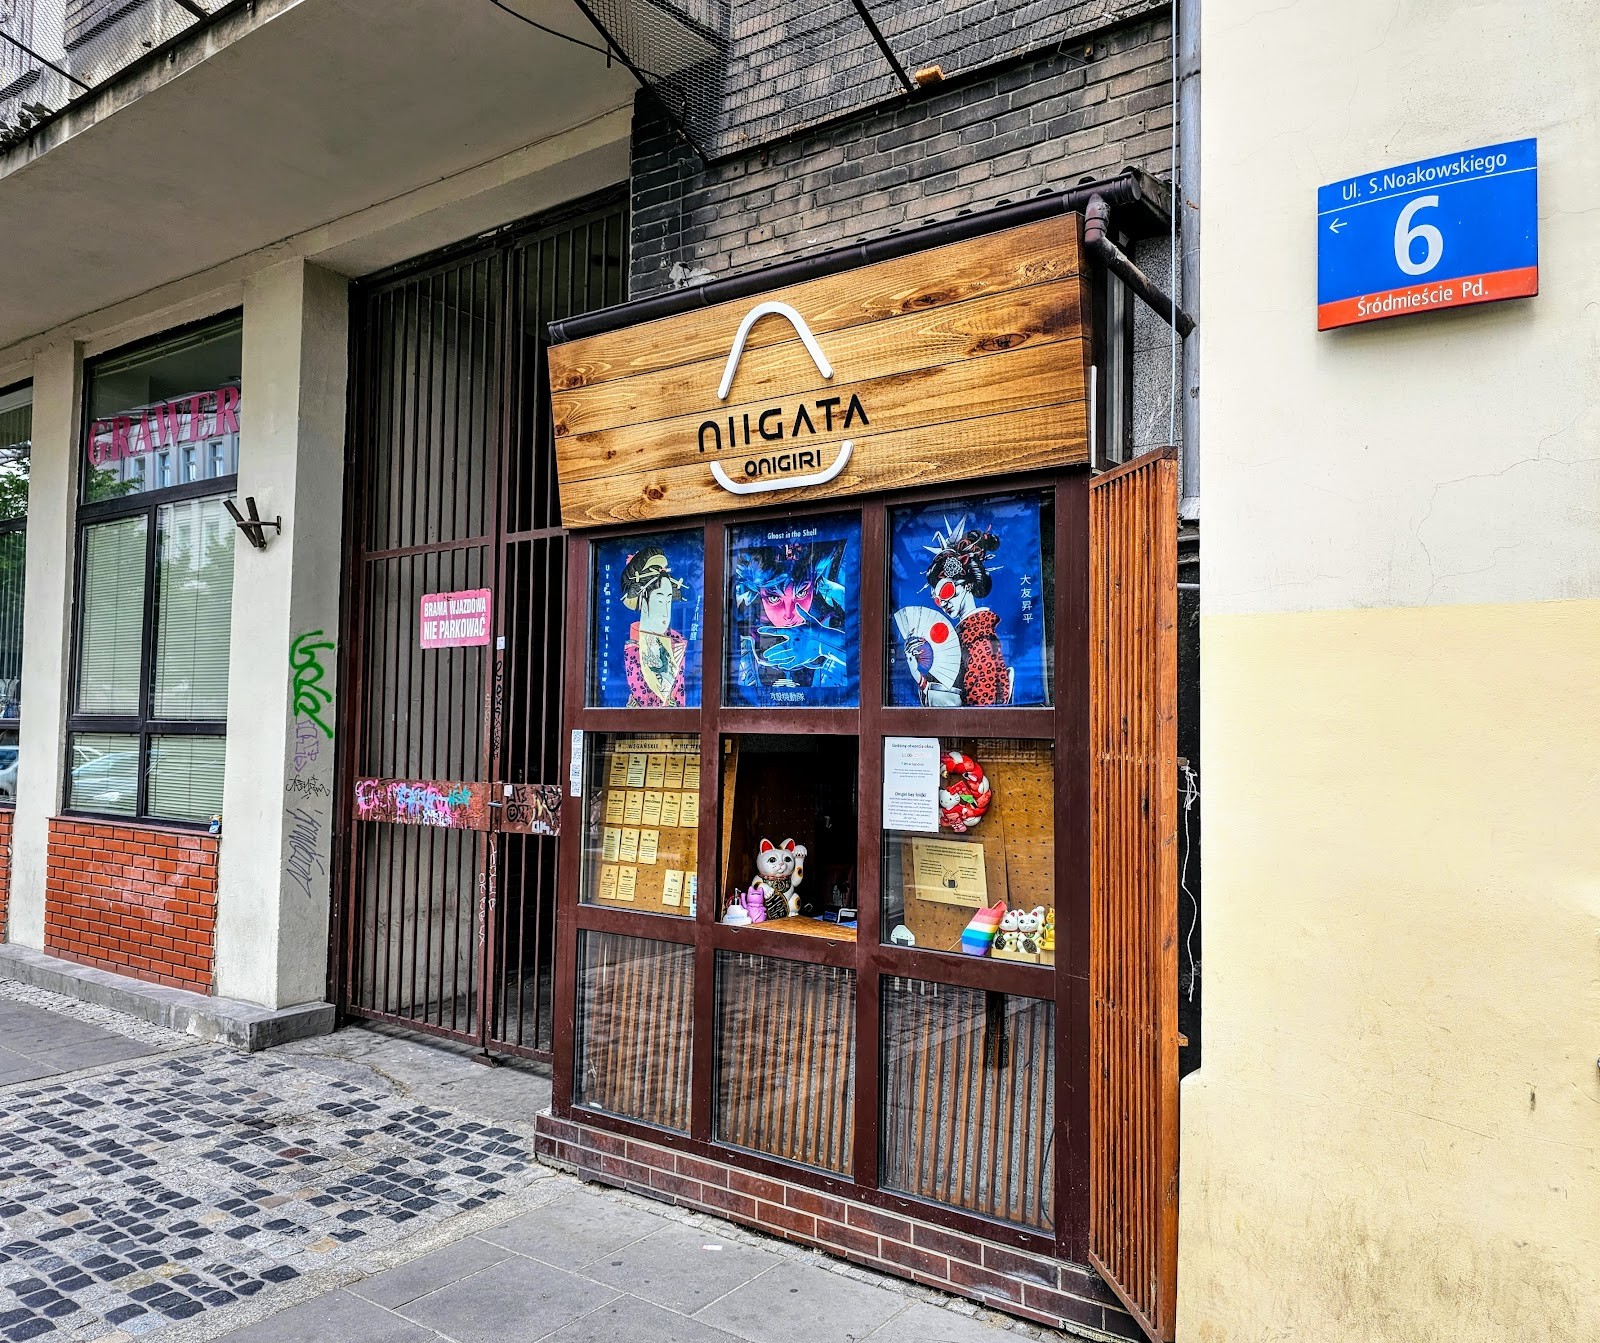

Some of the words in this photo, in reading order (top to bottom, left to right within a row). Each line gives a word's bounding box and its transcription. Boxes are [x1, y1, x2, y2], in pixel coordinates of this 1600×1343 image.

[1369, 153, 1507, 194] S.Noakowskiego
[1394, 195, 1444, 276] 6
[1357, 285, 1453, 317] Śródmieście
[1461, 279, 1489, 298] Pd.
[87, 386, 241, 466] GRAWER
[697, 393, 870, 453] NIIGATA
[744, 450, 821, 476] ONIGIRI
[767, 532, 784, 540] Ghost
[785, 531, 791, 539] in
[791, 530, 801, 538] the
[803, 528, 817, 537] Shell
[424, 602, 447, 617] BRAMA
[449, 598, 486, 614] WJAZDOWA
[1019, 574, 1034, 624] 大友昇平
[424, 622, 437, 640] NIE
[440, 613, 485, 639] PARKOWAĆ
